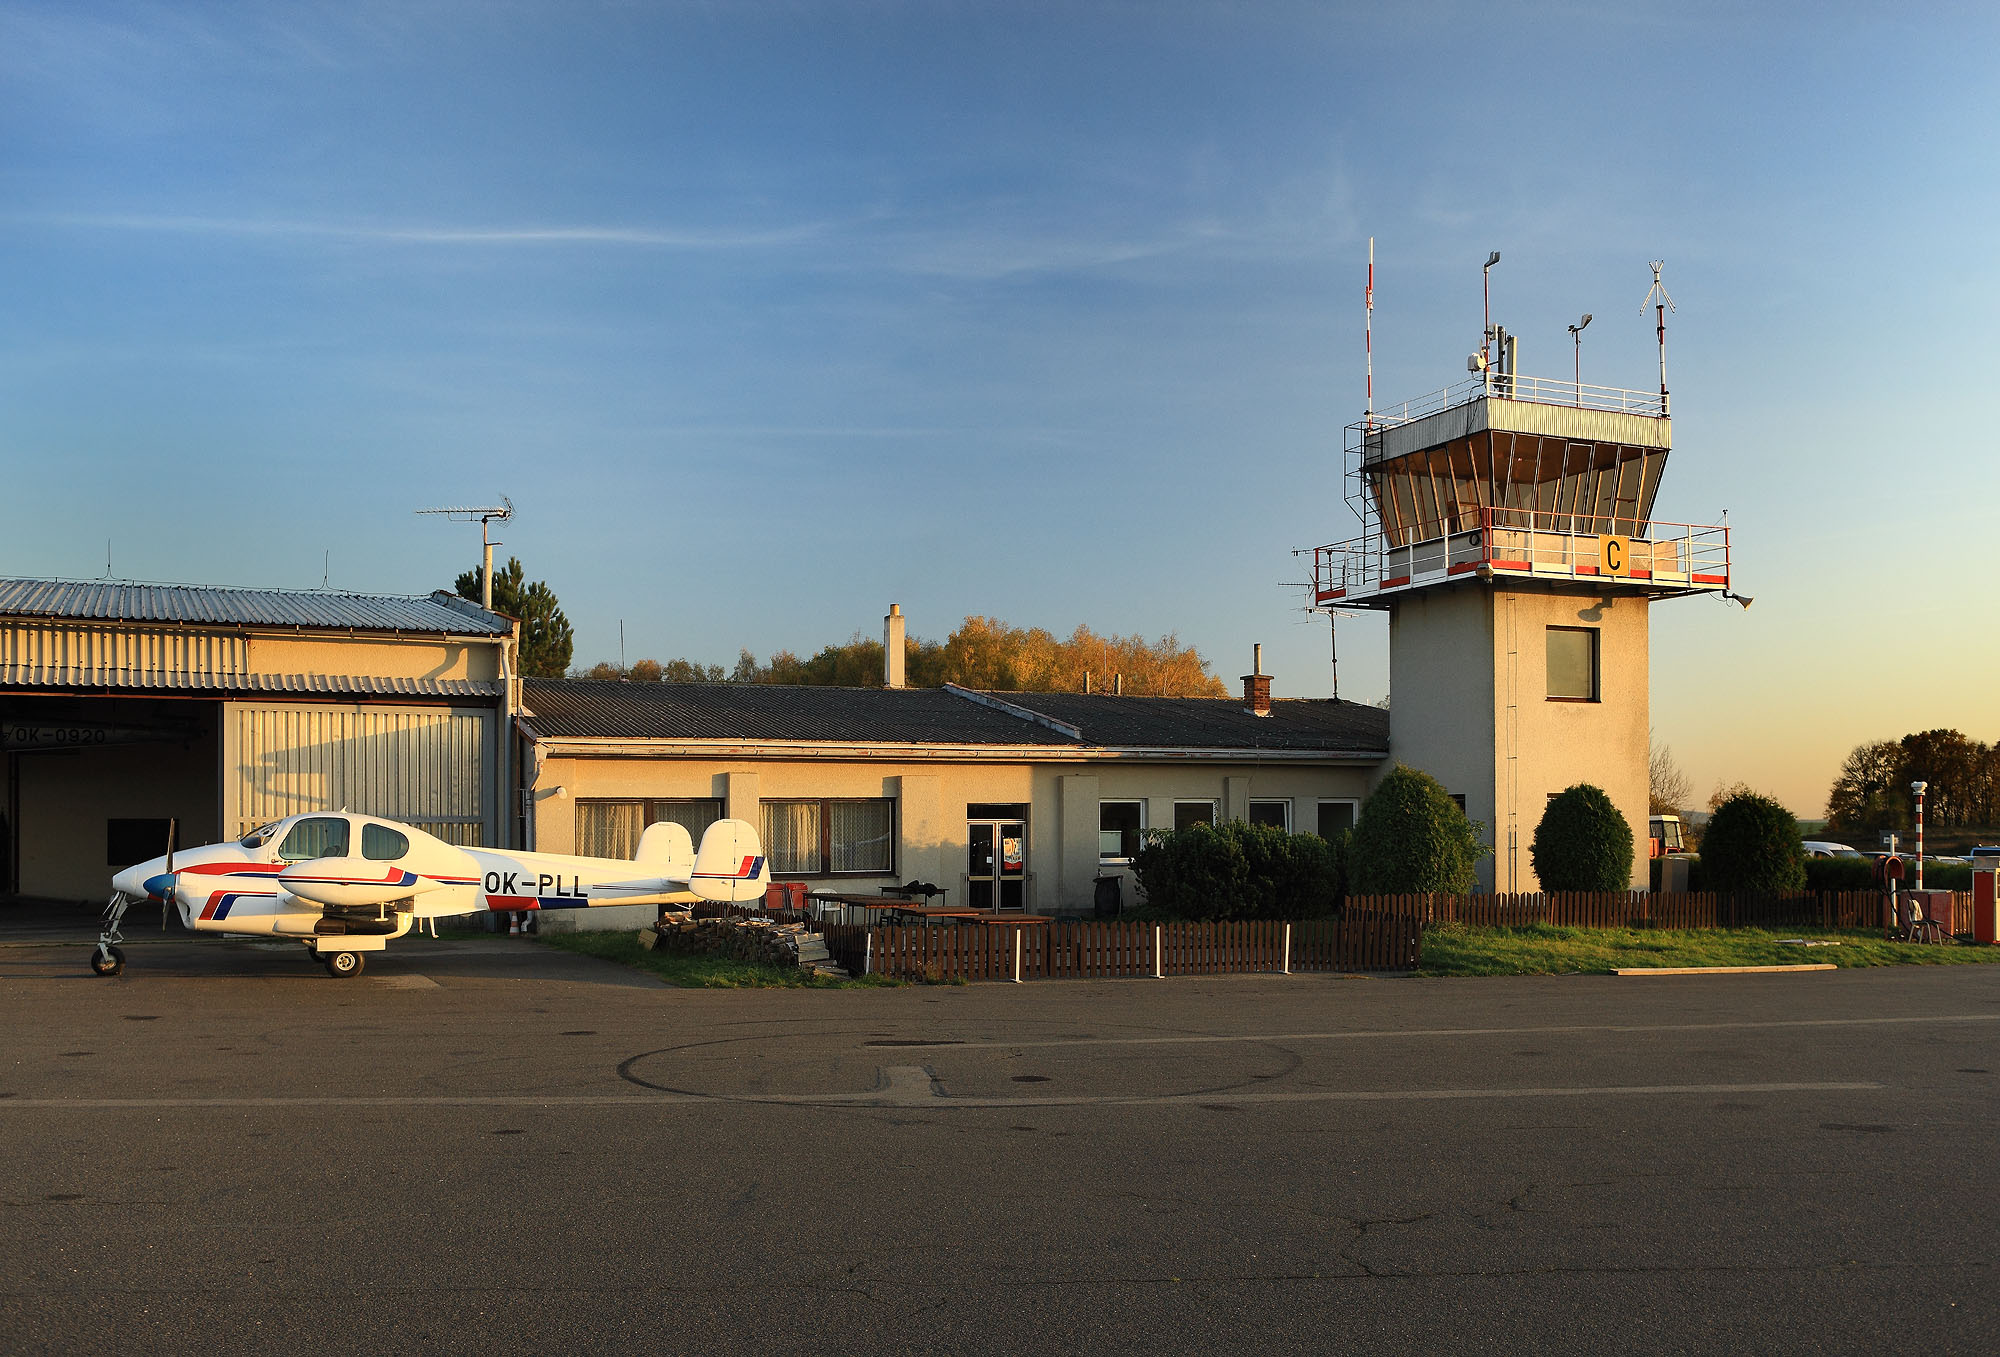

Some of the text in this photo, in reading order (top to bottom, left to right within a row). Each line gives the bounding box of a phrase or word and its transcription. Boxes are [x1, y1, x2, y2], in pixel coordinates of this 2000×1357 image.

[1607, 540, 1620, 570] C
[16, 728, 105, 743] OK-0920
[484, 871, 588, 897] OK-PLL
